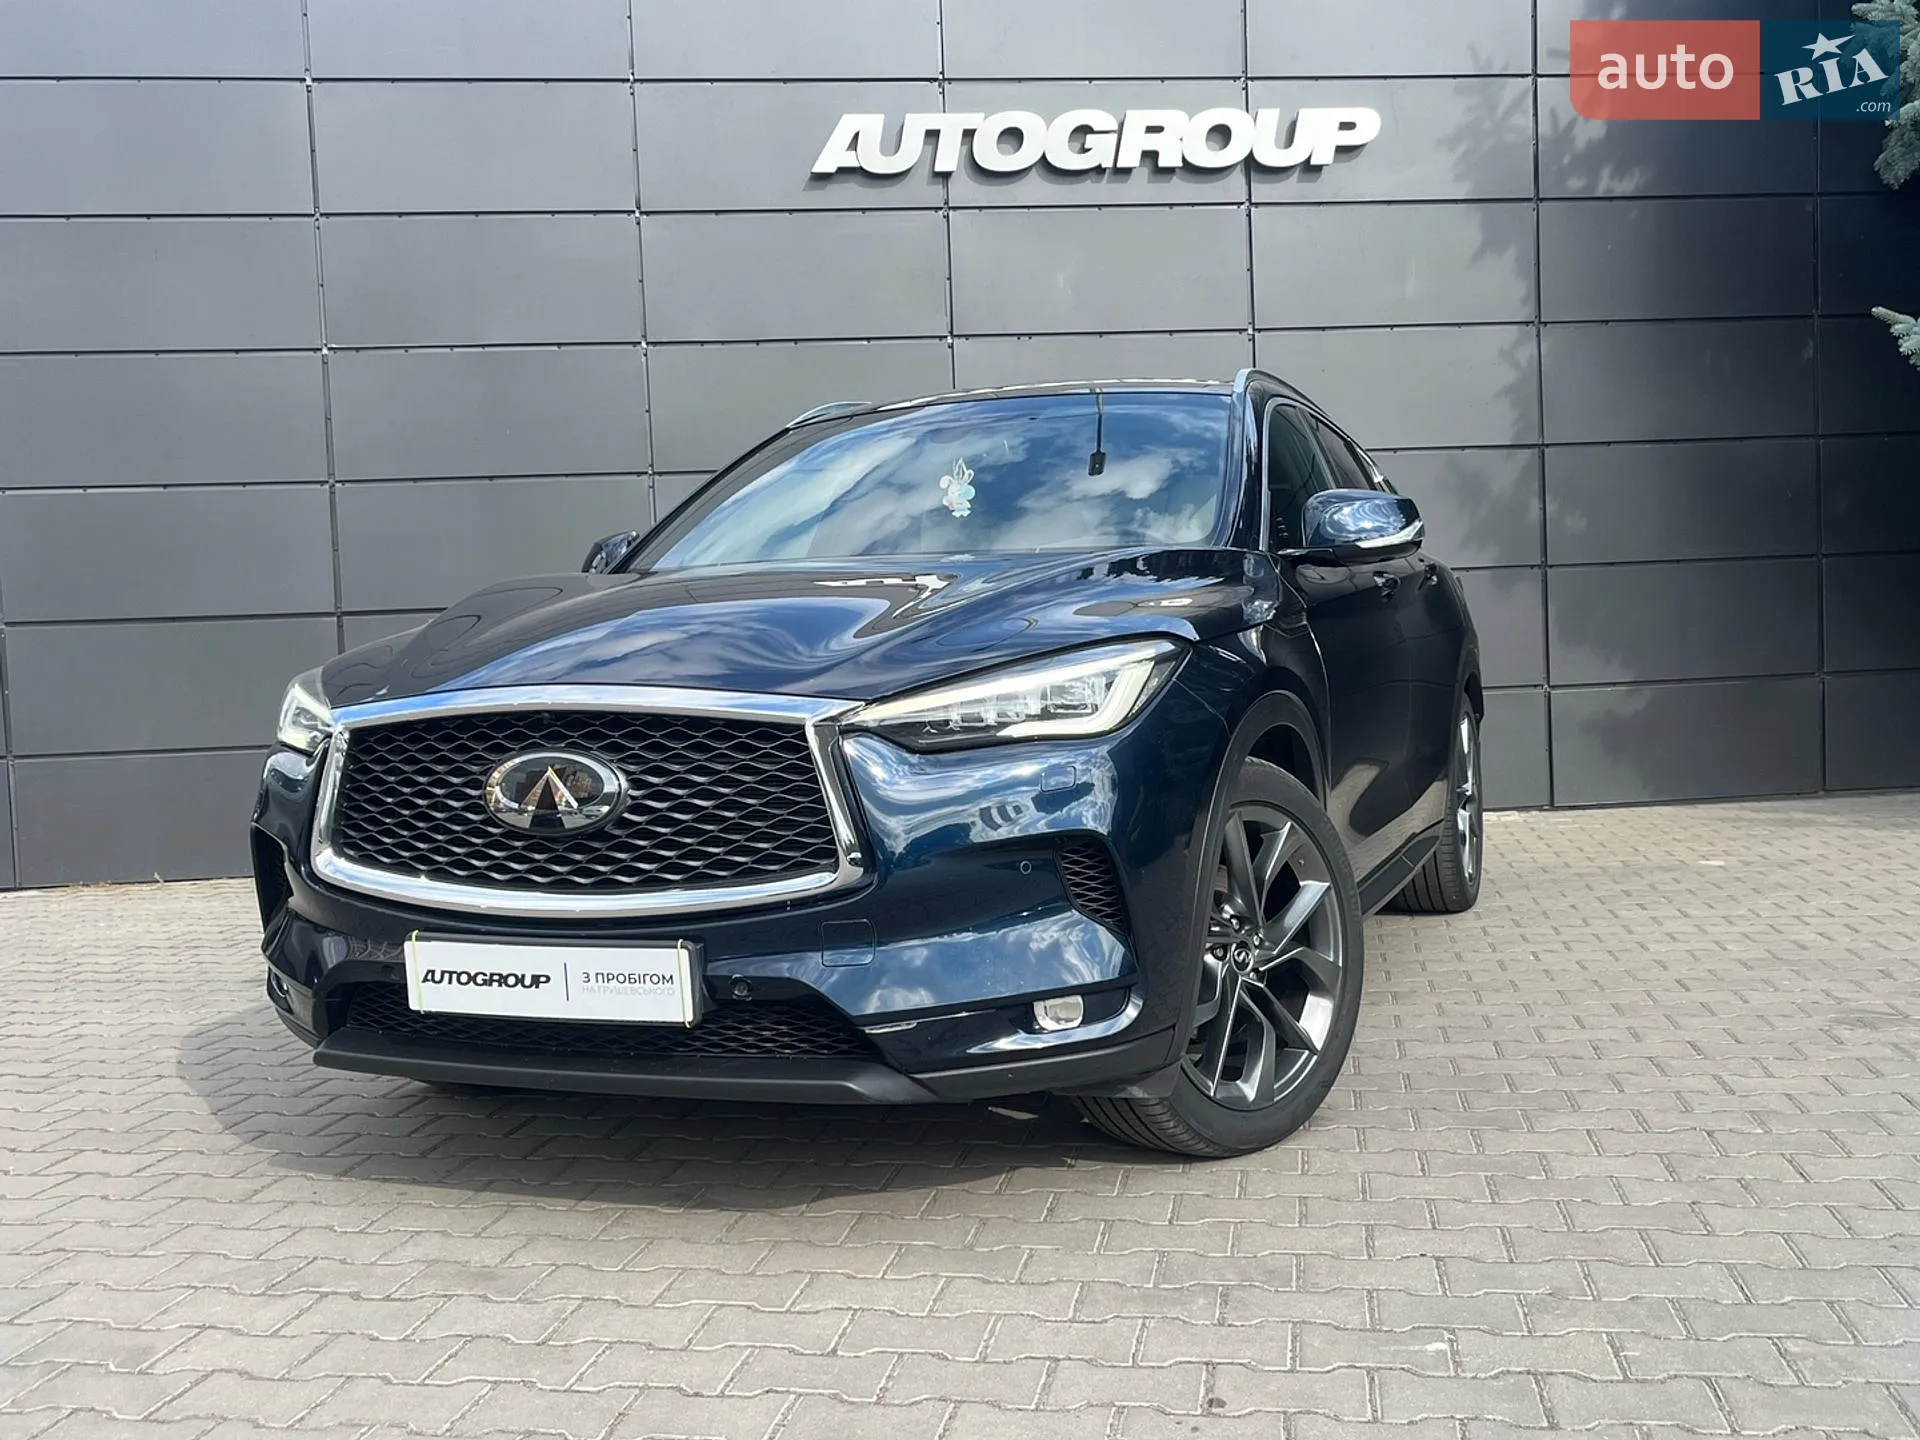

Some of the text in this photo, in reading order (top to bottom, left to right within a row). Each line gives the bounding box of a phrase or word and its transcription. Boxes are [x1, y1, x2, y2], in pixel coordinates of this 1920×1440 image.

[811, 108, 1382, 174] AUTOGROUP
[421, 969, 551, 989] AUTOGROUP
[595, 972, 674, 985] ПРОБІГОМ
